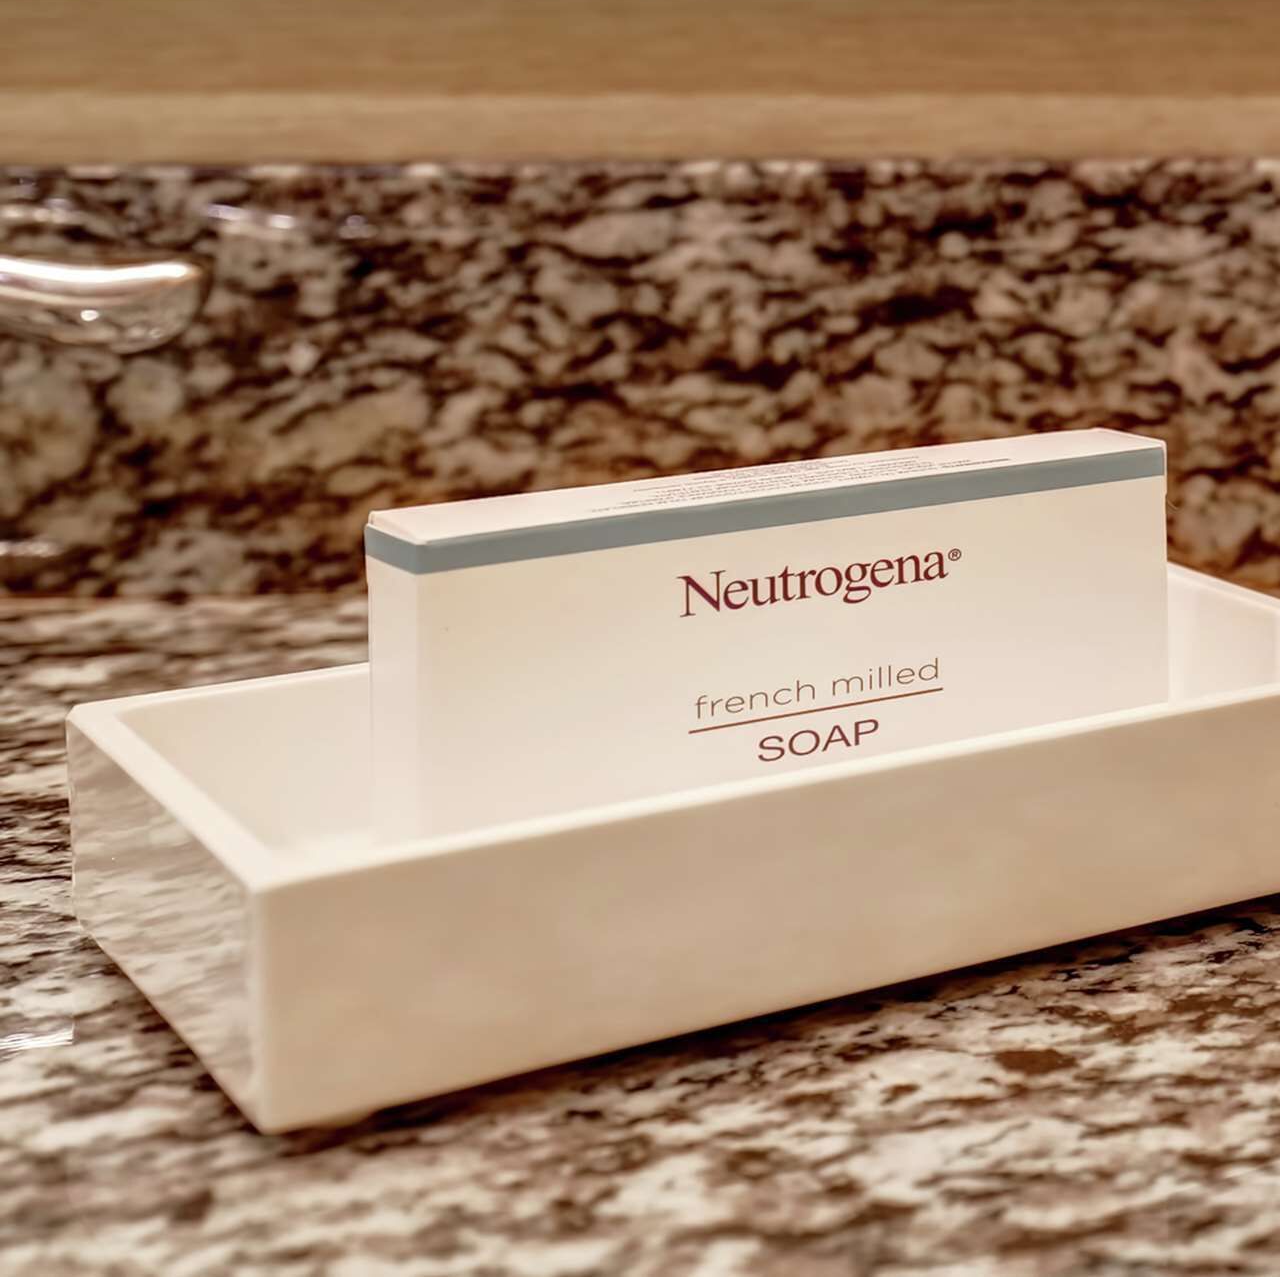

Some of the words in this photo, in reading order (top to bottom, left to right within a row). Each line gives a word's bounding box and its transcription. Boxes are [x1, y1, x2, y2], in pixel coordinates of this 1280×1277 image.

[693, 678, 816, 719] french
[831, 658, 941, 694] milled
[756, 718, 880, 764] SOAP
